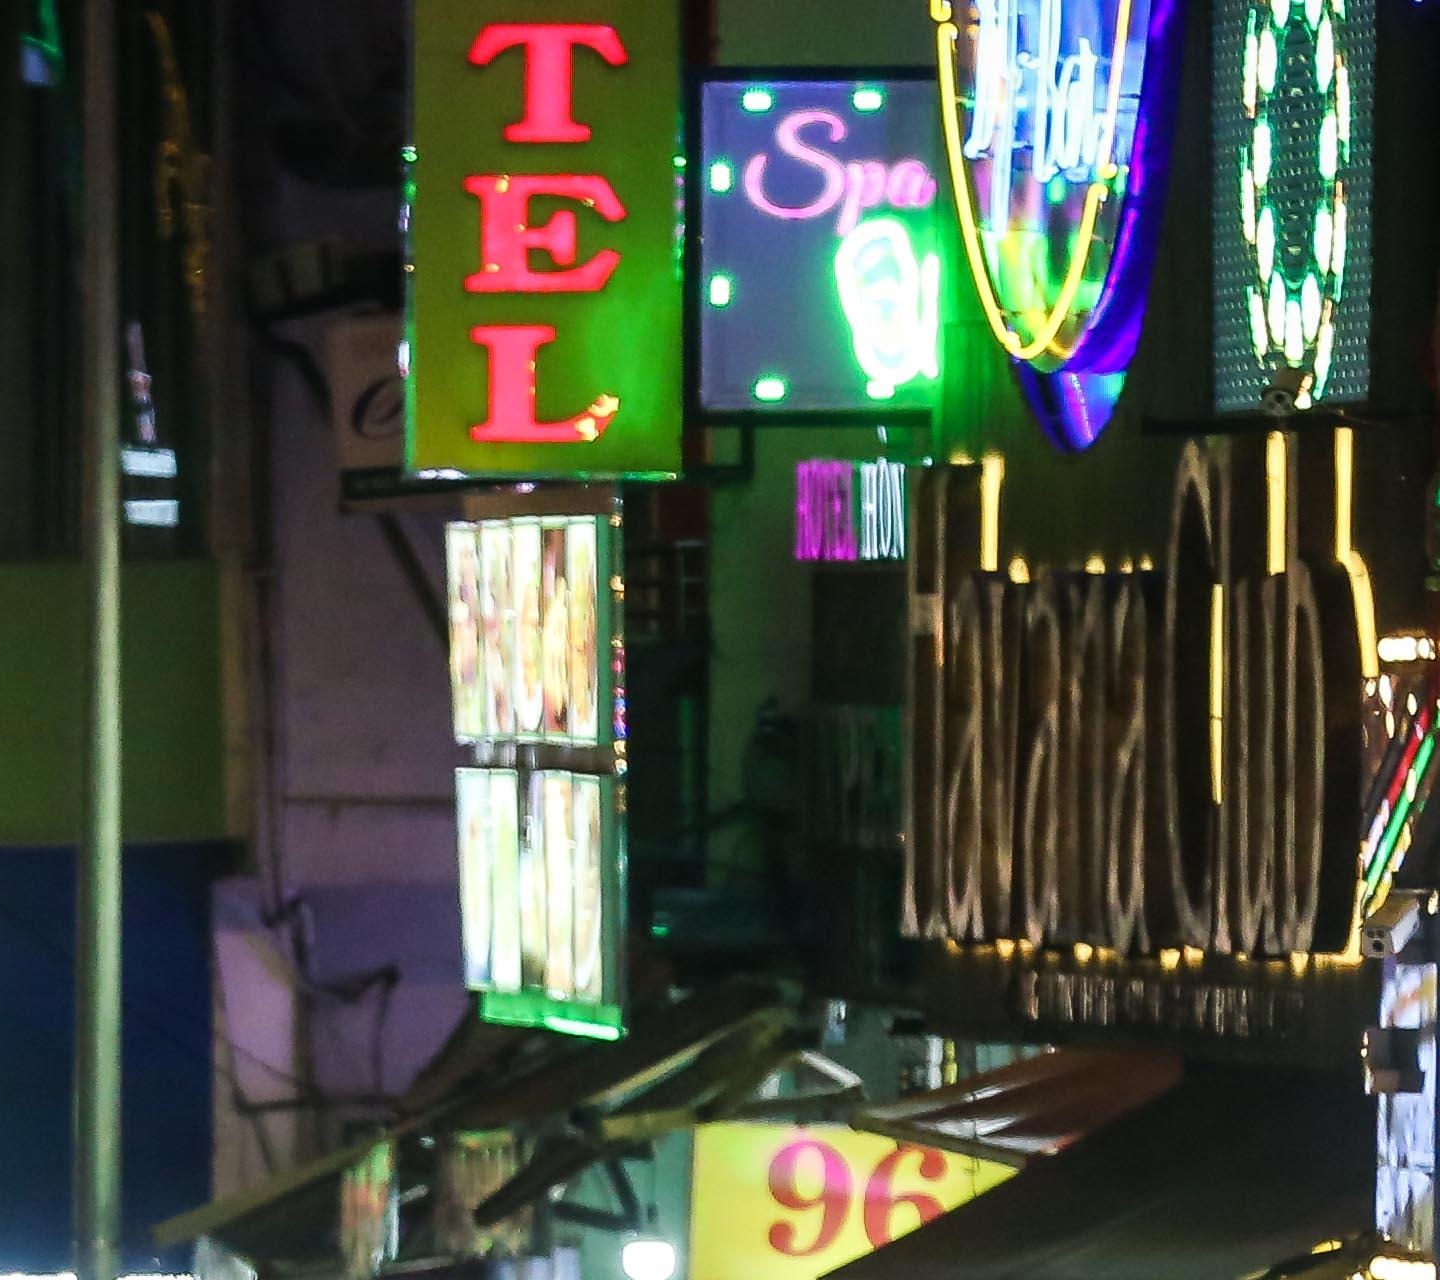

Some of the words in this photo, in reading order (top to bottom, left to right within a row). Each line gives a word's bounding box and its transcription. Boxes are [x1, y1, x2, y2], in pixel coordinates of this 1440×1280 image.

[464, 22, 628, 444] TEL
[744, 111, 937, 235] Spa
[767, 1137, 949, 1258] 96
